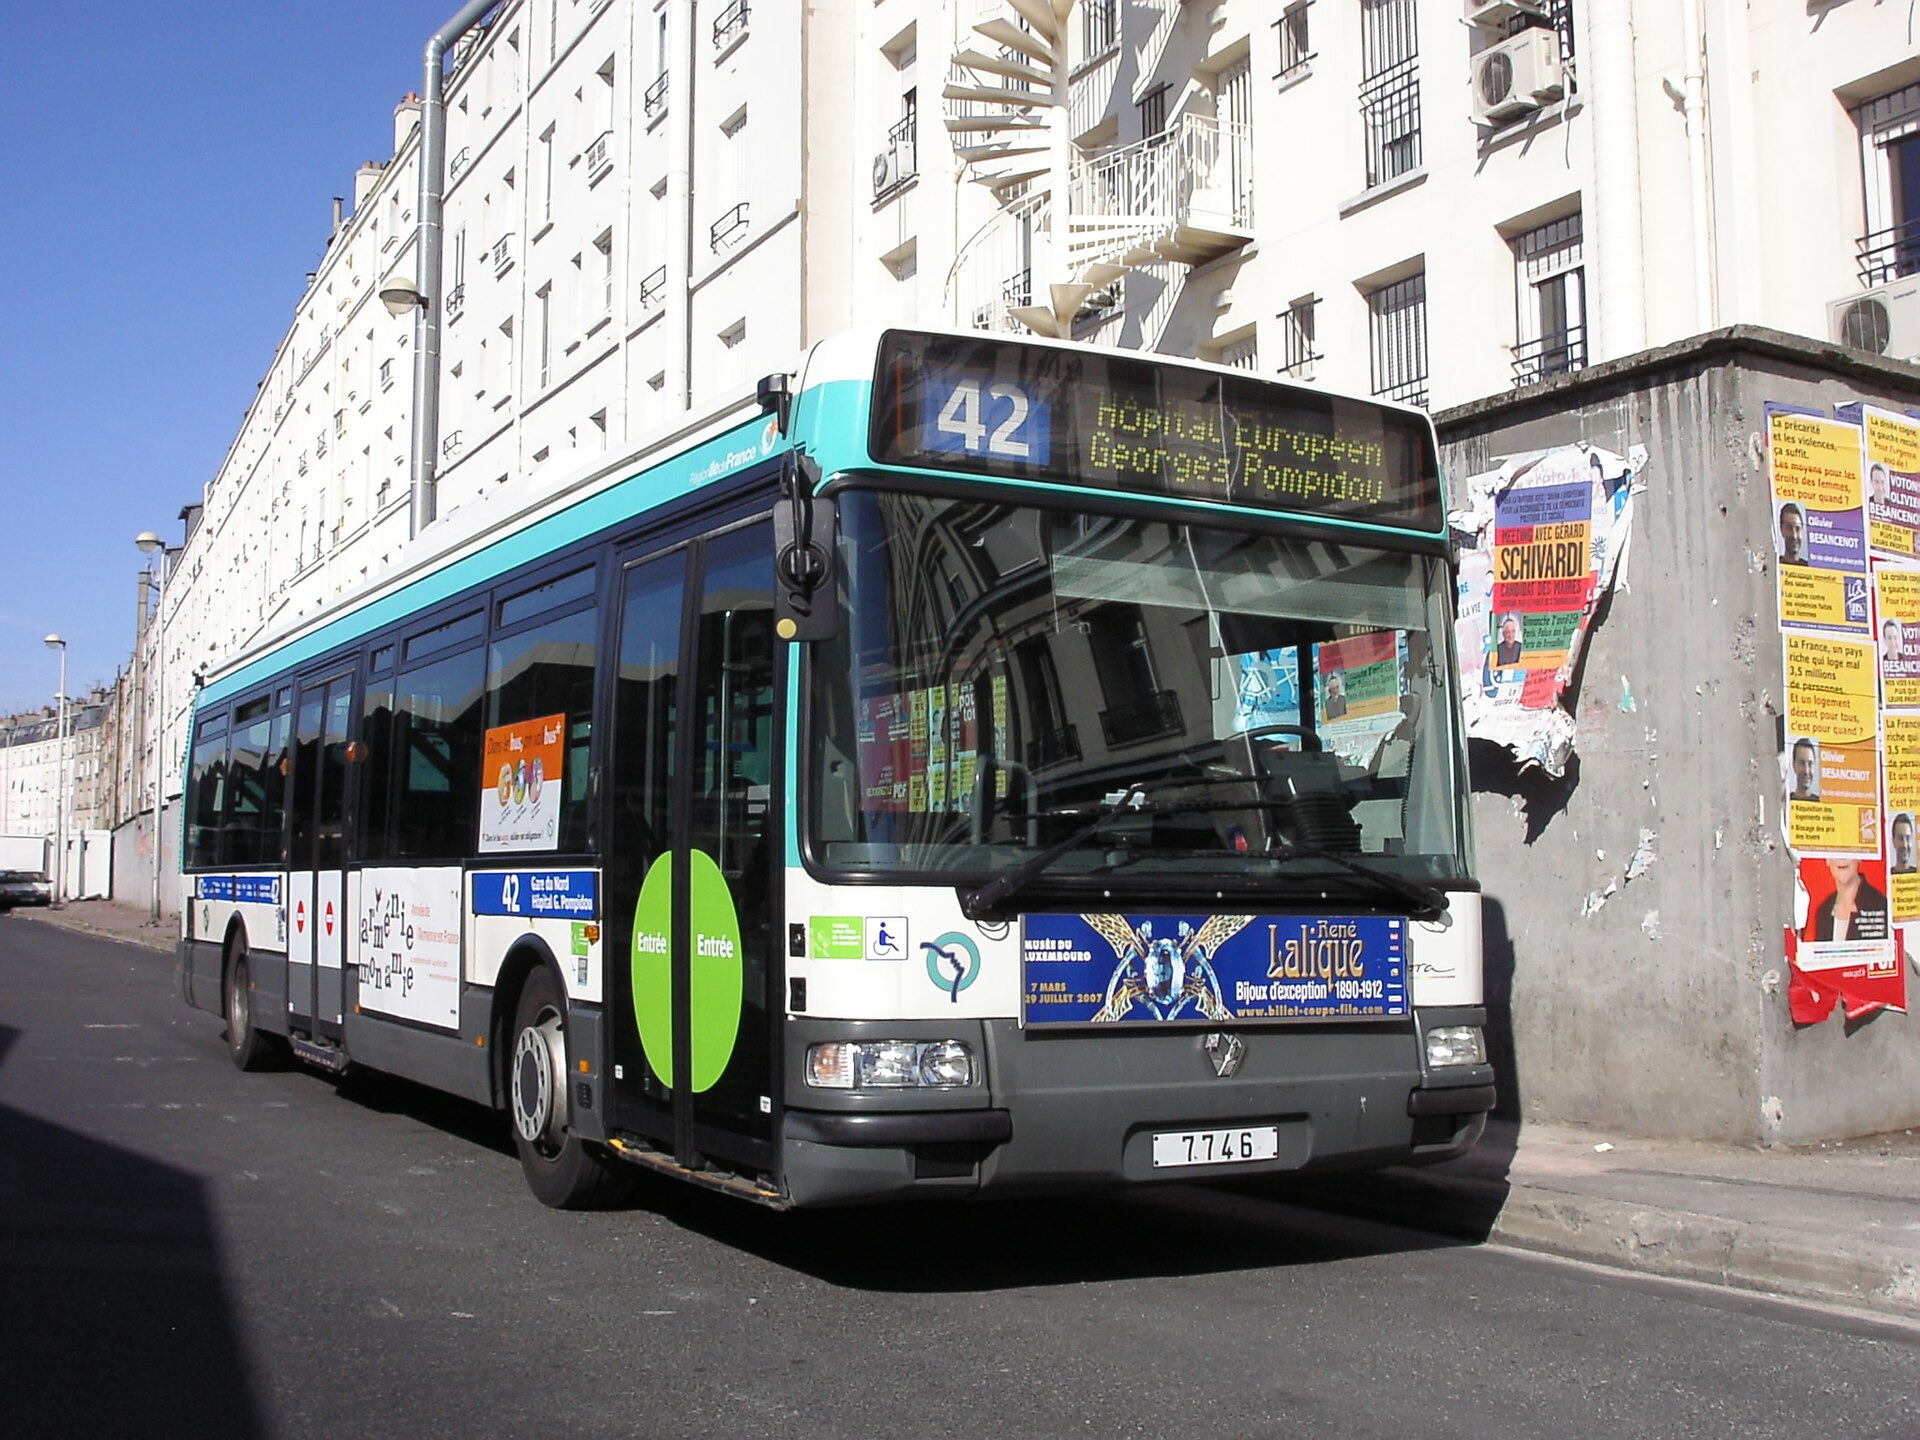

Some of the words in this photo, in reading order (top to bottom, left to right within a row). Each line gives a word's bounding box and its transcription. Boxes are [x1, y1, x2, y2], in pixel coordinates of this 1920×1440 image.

[937, 377, 1031, 458] 42
[1772, 417, 1782, 427] La
[1784, 421, 1821, 435] précarité
[1871, 416, 1878, 425] La
[1880, 420, 1897, 430] droite
[1098, 393, 1221, 444] Hôpital
[1235, 412, 1382, 467] Européen
[1870, 428, 1876, 436] la
[1877, 432, 1898, 443] gauche
[1773, 433, 1781, 441] et
[1784, 433, 1795, 444] les
[1798, 437, 1837, 452] violences,
[1874, 441, 1888, 451] Pour
[1774, 447, 1783, 456] ça
[1785, 449, 1809, 460] suffit.
[1091, 431, 1231, 484] Georges
[1243, 452, 1384, 505] Pompidou
[1775, 459, 1788, 469] Les
[1791, 463, 1822, 474] moyens
[1824, 468, 1842, 478] pour
[1844, 470, 1856, 480] les
[1775, 473, 1799, 484] droits
[1801, 477, 1816, 487] des
[1818, 479, 1851, 494] femmes,
[1776, 486, 1795, 497] c'est
[1797, 490, 1816, 501] pour
[1819, 493, 1843, 505] quand
[1845, 495, 1850, 505] ?
[1891, 491, 1920, 509] OLIVIE
[1870, 502, 1920, 525] BESANCENO
[1808, 516, 1834, 529] Olivier
[1502, 528, 1534, 544] MEETING
[1535, 526, 1553, 541] AVEC
[1554, 521, 1585, 540] GÉRARD
[1809, 532, 1859, 549] BESANCENOT
[1500, 541, 1584, 581] SCHIVARDI
[1501, 581, 1534, 597] CANDIDAT
[1537, 580, 1551, 596] DES
[1554, 578, 1582, 594] MAIRES
[1462, 607, 1470, 618] LA
[1470, 601, 1481, 614] VIE
[1789, 638, 1799, 649] La
[1801, 640, 1831, 653] France,
[1833, 646, 1843, 654] un
[1845, 648, 1863, 658] pays
[1789, 652, 1810, 664] riche
[1812, 656, 1825, 666] qui
[1827, 656, 1843, 669] loge
[1846, 660, 1860, 669] mal
[1790, 666, 1803, 677] 3,5
[1805, 668, 1836, 680] millions
[1790, 680, 1800, 689] de
[1790, 693, 1799, 703] Et
[1801, 696, 1812, 704] un
[1814, 695, 1851, 708] logement
[1790, 707, 1818, 719] décent
[1820, 712, 1838, 721] pour
[1791, 721, 1810, 731] c'est
[1812, 725, 1831, 735] pour
[1833, 726, 1857, 736] quand
[1859, 727, 1864, 736] ?
[1886, 719, 1895, 728] La
[1887, 732, 1905, 741] riche
[1907, 733, 1918, 743] qui
[1821, 768, 1870, 782] BESANCENOT
[1889, 771, 1896, 780] Et
[1889, 784, 1914, 794] décent
[1890, 798, 1907, 807] c'est
[531, 875, 545, 891] Gare
[545, 875, 554, 891] du
[554, 875, 570, 891] Nord
[502, 874, 520, 912] 42
[531, 894, 553, 913] Hôpital
[553, 894, 561, 910] G.
[561, 894, 593, 914] Pompidou
[1317, 919, 1357, 938] René
[637, 931, 667, 954] Entrée
[697, 934, 733, 958] Entrée
[1025, 937, 1056, 950] MUSÉE
[1057, 939, 1072, 950] DU
[1025, 951, 1092, 962] LUXEMBOURG
[1266, 924, 1364, 993] Lalique
[359, 957, 382, 989] mon
[384, 952, 414, 998] amie
[1031, 982, 1038, 992] 7
[1039, 982, 1067, 992] MARS
[1236, 981, 1268, 1005] Bijoux
[1269, 980, 1328, 1003] d'exception
[1334, 980, 1384, 999] 1890-1912
[1038, 994, 1073, 1004] JUILLET
[1077, 993, 1103, 1003] 2007
[1236, 1003, 1384, 1017] www.billet-coupe-file.com
[1182, 1132, 1253, 1162] 7746
